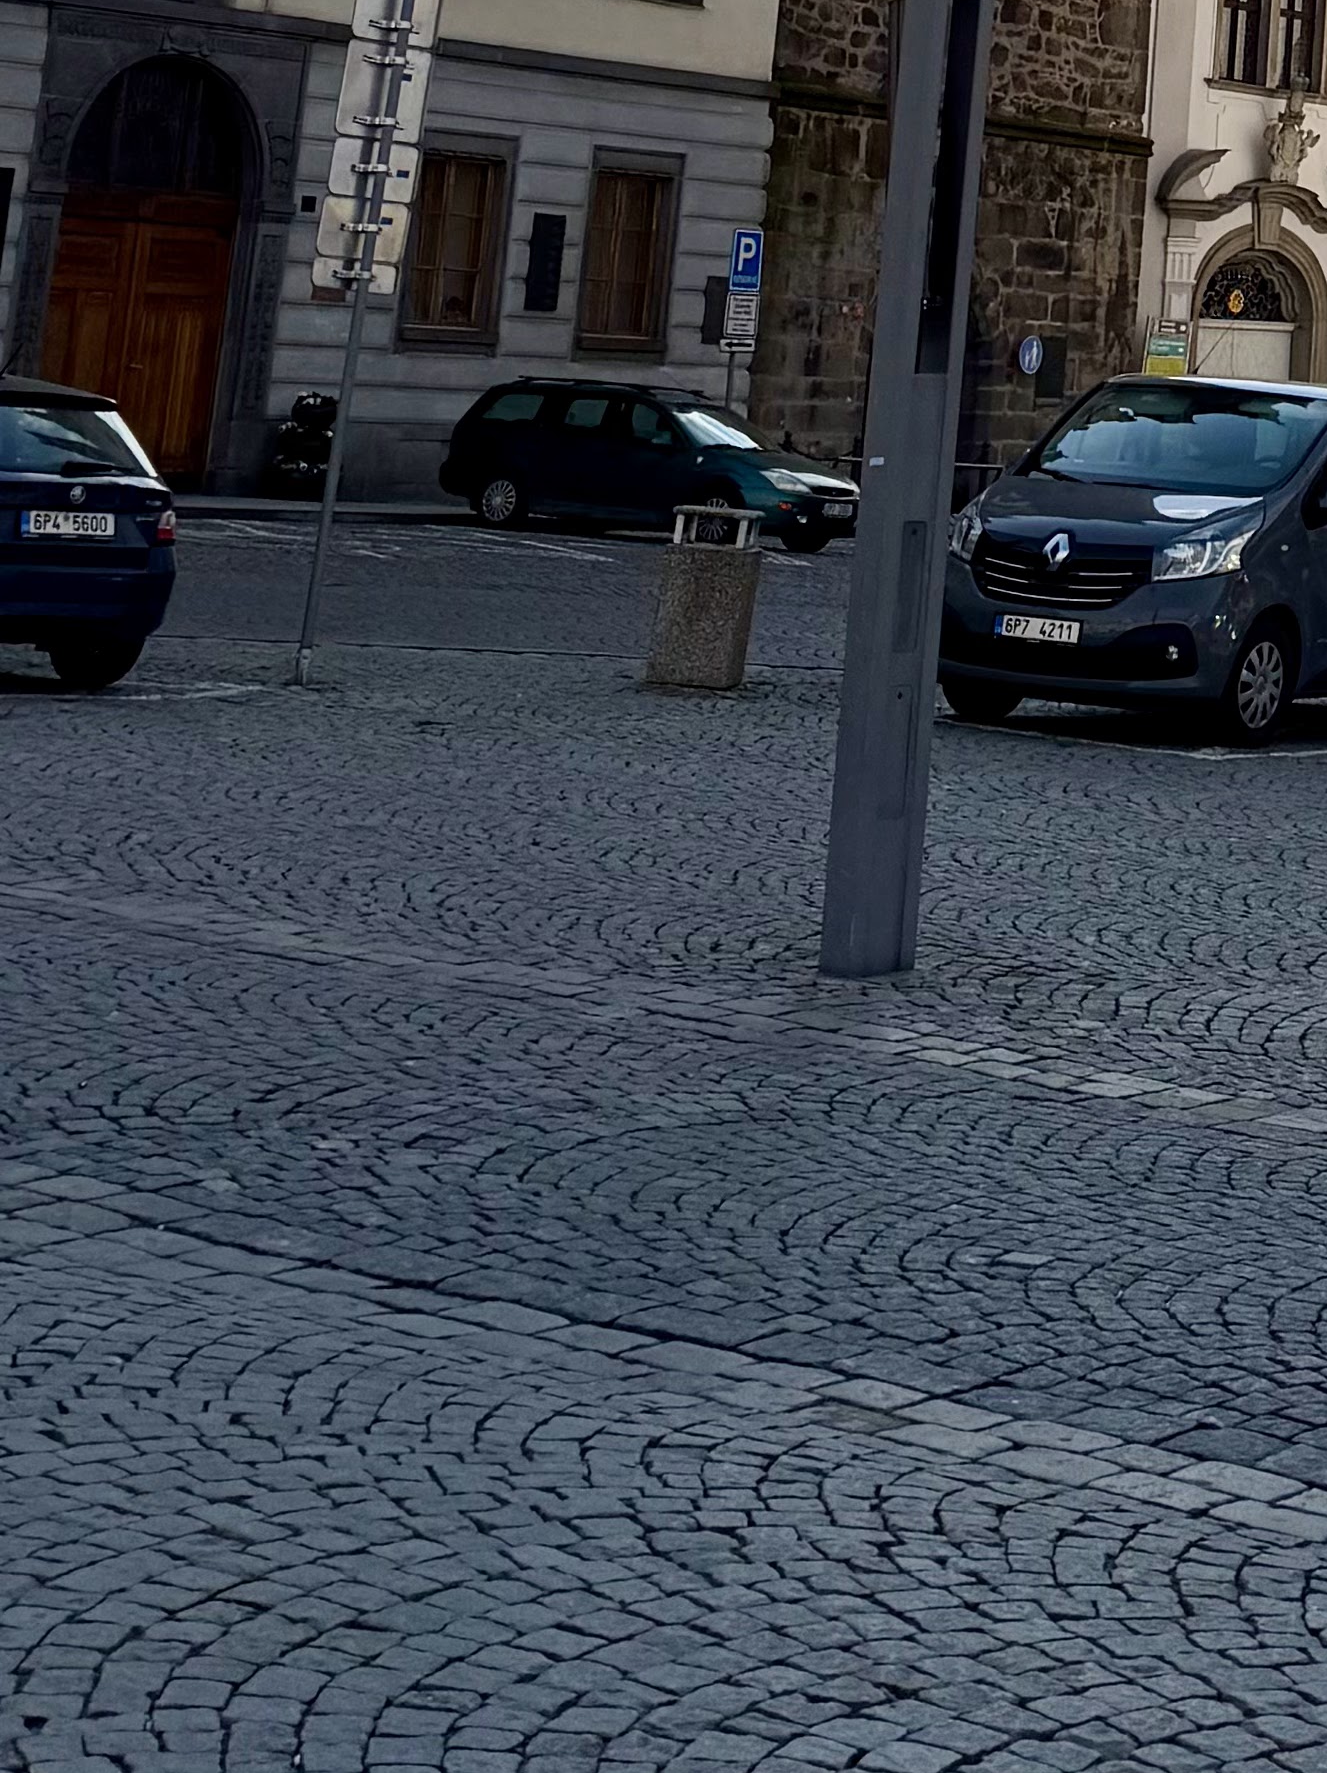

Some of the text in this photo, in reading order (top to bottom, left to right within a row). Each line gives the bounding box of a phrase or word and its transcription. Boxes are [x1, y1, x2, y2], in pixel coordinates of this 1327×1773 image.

[737, 237, 757, 272] P
[33, 513, 107, 533] 6P4 5600
[1004, 617, 1073, 641] 6P7 4211
